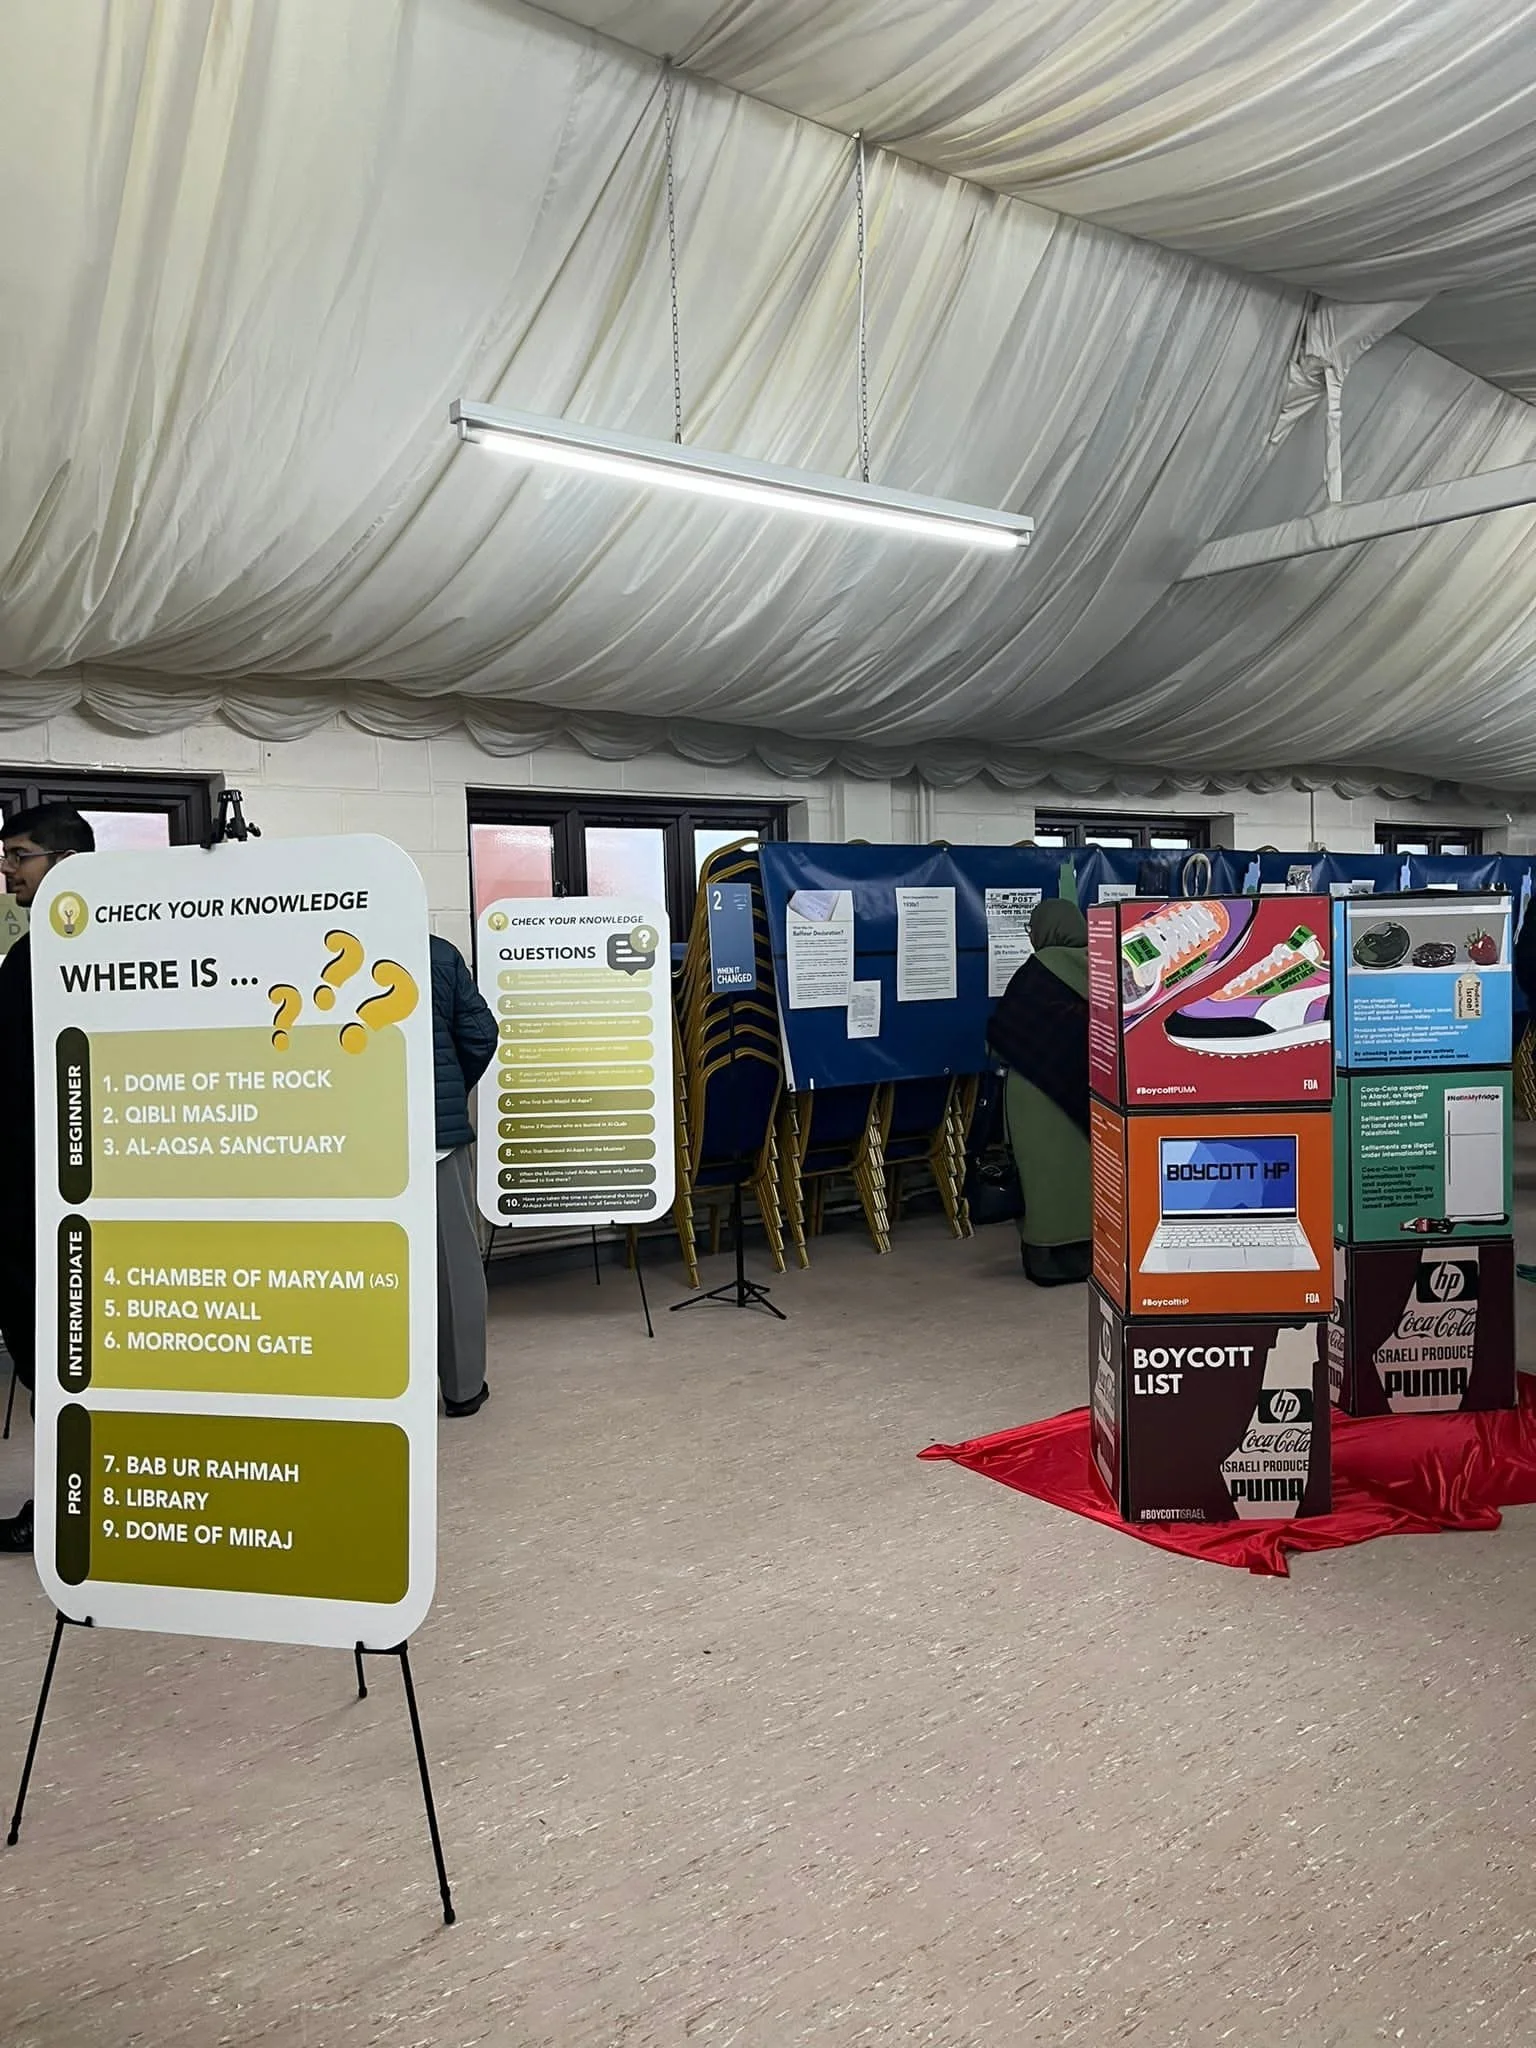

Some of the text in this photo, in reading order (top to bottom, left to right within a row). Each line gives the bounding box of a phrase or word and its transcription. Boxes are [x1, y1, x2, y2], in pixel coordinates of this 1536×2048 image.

[95, 891, 369, 924] CHECK YOUR KNOWLEDGE
[713, 891, 722, 910] 2
[512, 915, 644, 926] CHECK YOUR KNOWLEDGE
[499, 946, 596, 961] QUESTIONS
[60, 960, 179, 993] WHERE
[192, 958, 218, 988] IS
[717, 974, 752, 984] CHANGED
[104, 1069, 333, 1094] 1. DOME OF THE ROCK
[1136, 1086, 1196, 1095] #BoycottPUMA
[1304, 1079, 1318, 1090] FOA
[505, 1098, 514, 1107] 6.
[68, 1065, 82, 1166] BEGINNER
[103, 1103, 258, 1125] 2. QIBLI MASJID
[505, 1123, 514, 1132] 7.
[104, 1134, 347, 1156] 3. AL-AQSA SANCTUARY
[505, 1148, 514, 1157] 8.
[505, 1173, 514, 1182] 9.
[1167, 1162, 1290, 1181] BOYCOTT HP
[506, 1199, 520, 1208] 10.
[104, 1268, 399, 1290] 4. CHAMBER OF MARYAM (AS)
[1435, 1262, 1461, 1302] hp
[68, 1230, 83, 1376] INTERMEDIATE
[1142, 1298, 1189, 1307] #BoycottHP
[1305, 1293, 1320, 1304] FOA
[104, 1300, 261, 1321] 5. BURAQ WALL
[104, 1332, 313, 1356] 6. MORROCON GATE
[1375, 1345, 1474, 1363] ISRAELI PRODUCE
[1133, 1346, 1254, 1368] BOYCOTT
[1134, 1373, 1183, 1395] LIST
[1384, 1367, 1468, 1398] PUMA
[1274, 1390, 1297, 1422] hp
[103, 1455, 299, 1483] 7. BAB UR RAHMAH
[1222, 1460, 1309, 1472] ISRAELI PRODUCE
[68, 1473, 82, 1515] PRO
[103, 1487, 209, 1511] 8. LIBRARY
[1231, 1478, 1304, 1501] PUMA
[1141, 1508, 1206, 1520] #BOYCOTTISRAEL
[103, 1520, 294, 1550] 9. DOME OF MIRAJ
